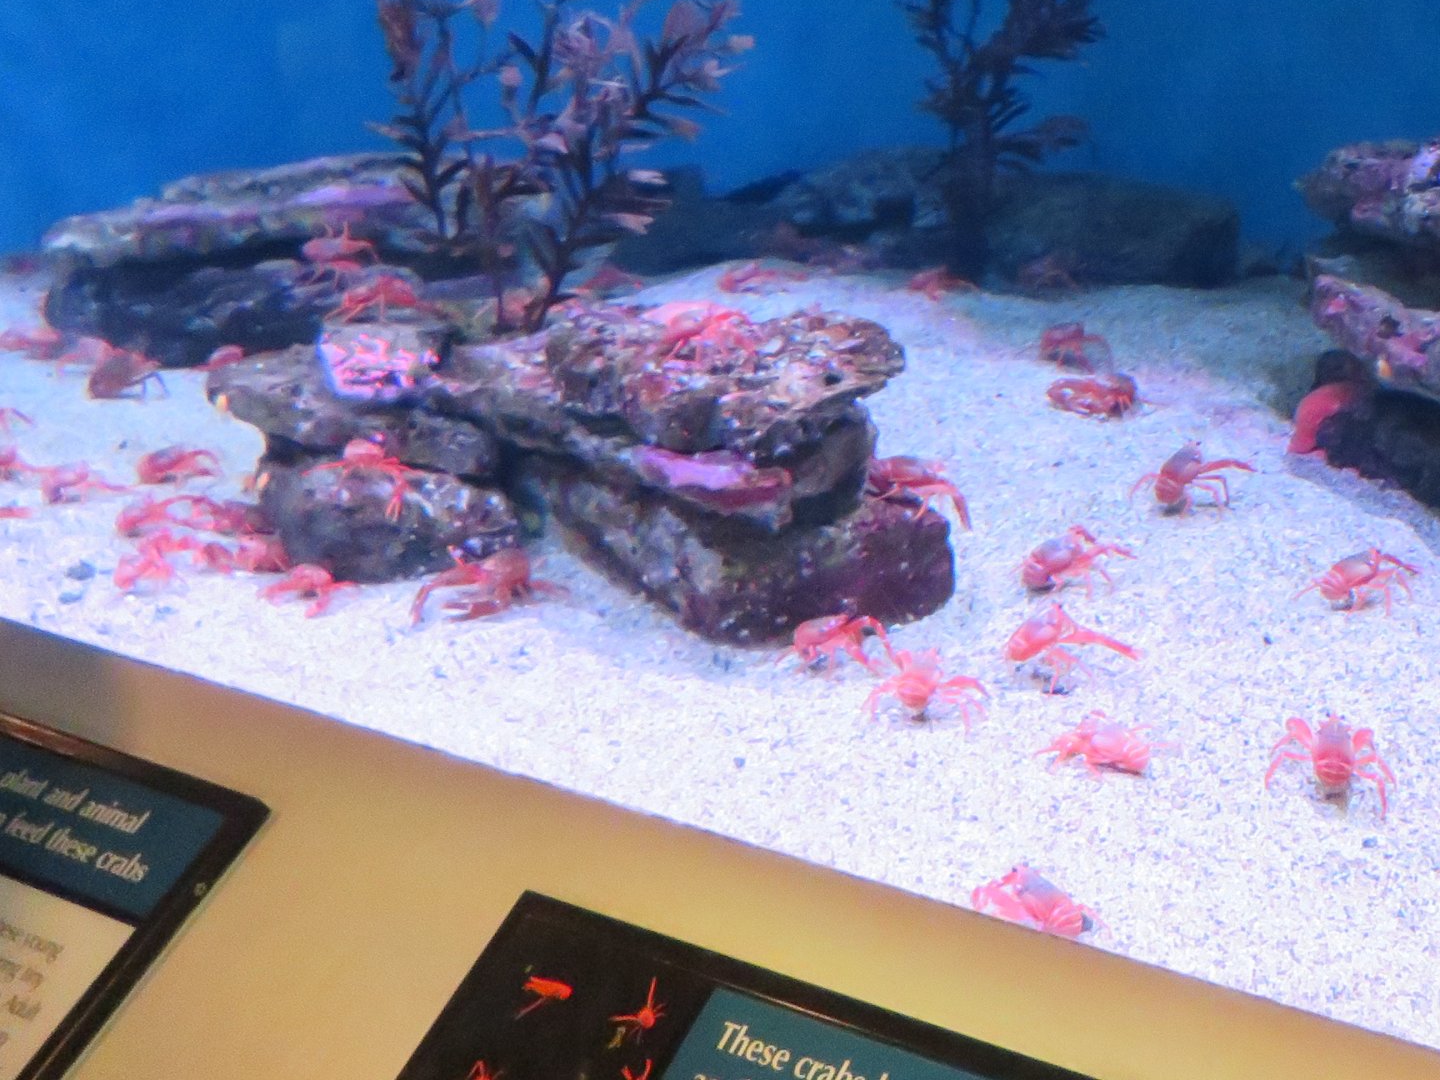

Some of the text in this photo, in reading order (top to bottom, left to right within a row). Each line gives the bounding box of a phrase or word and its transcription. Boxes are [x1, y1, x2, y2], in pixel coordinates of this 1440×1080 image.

[43, 788, 91, 811] and
[79, 801, 151, 834] animal
[45, 828, 98, 863] these
[96, 852, 149, 883] crabs
[715, 1021, 866, 1080] These crab
